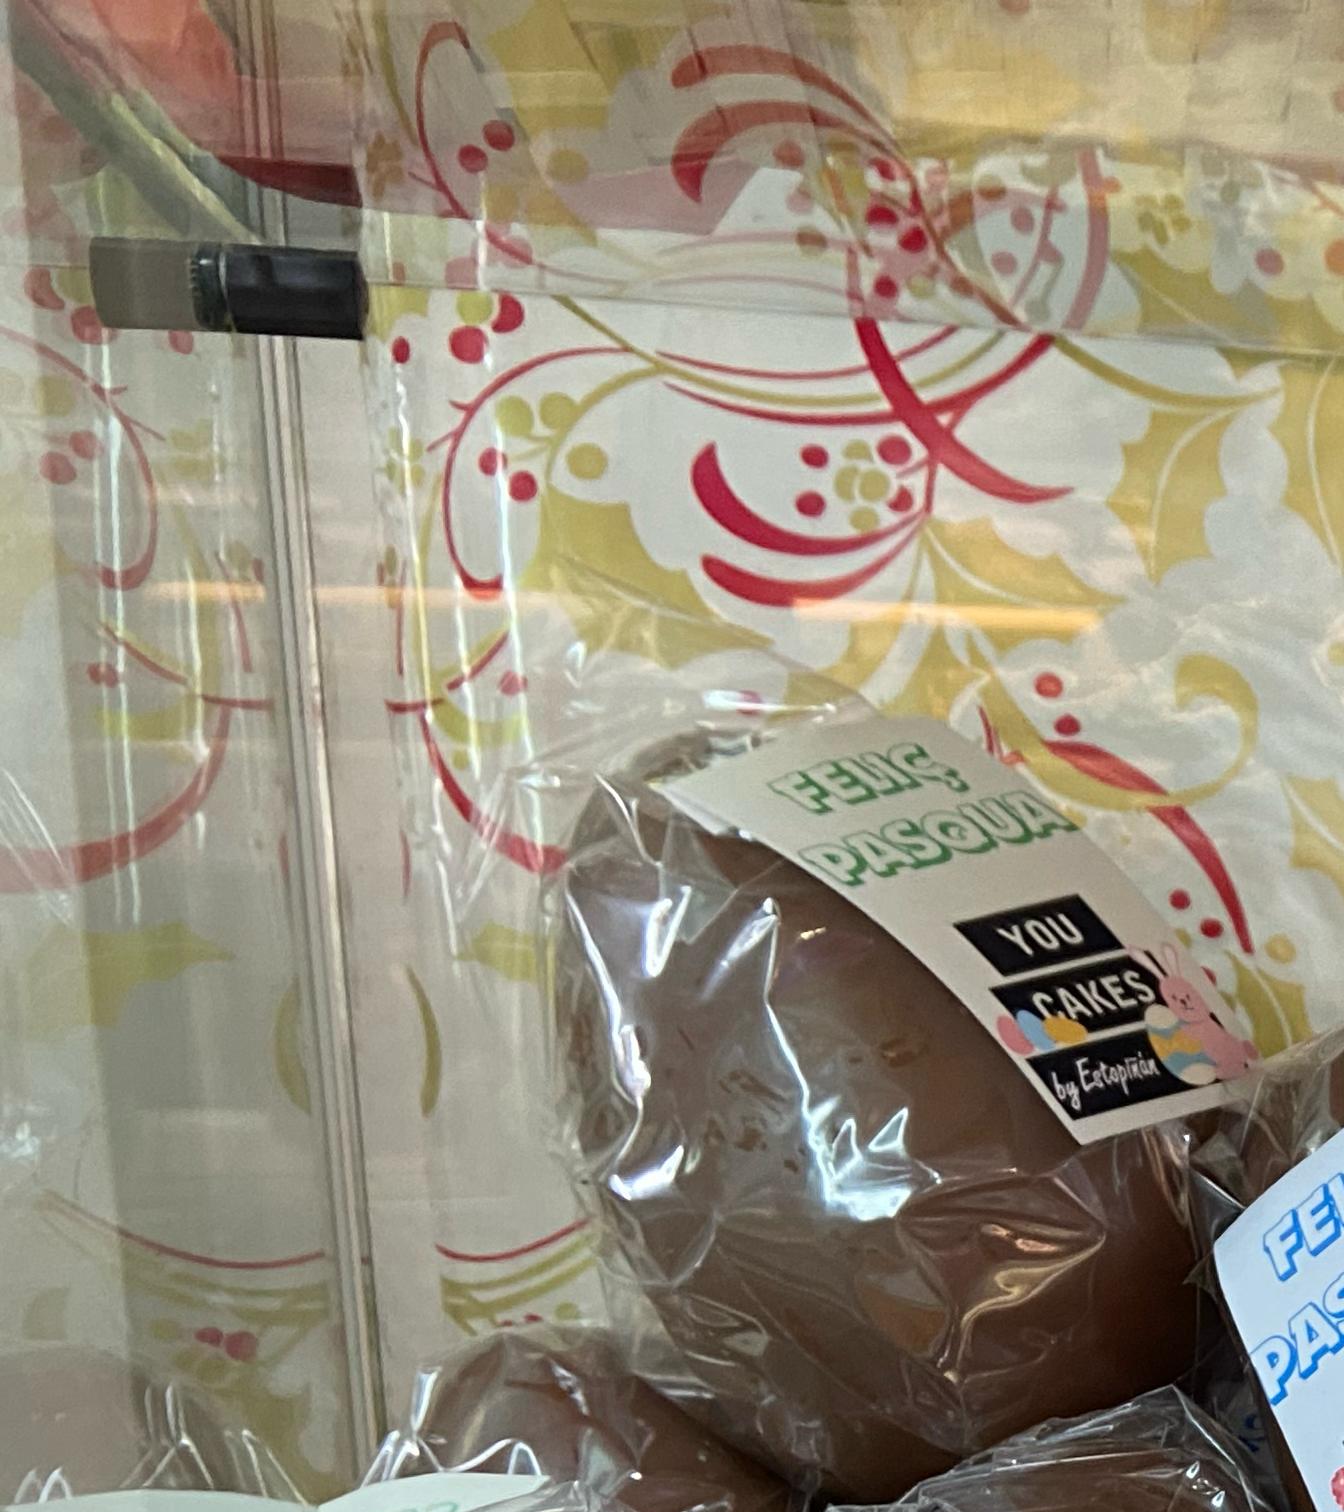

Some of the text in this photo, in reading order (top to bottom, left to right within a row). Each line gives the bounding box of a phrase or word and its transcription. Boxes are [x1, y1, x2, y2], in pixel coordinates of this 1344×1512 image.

[767, 742, 971, 814] FELIÇ
[800, 791, 1082, 887] PASQUA
[998, 912, 1085, 955] YOU
[1031, 967, 1156, 1022] CAKES
[1051, 1074, 1081, 1111] by
